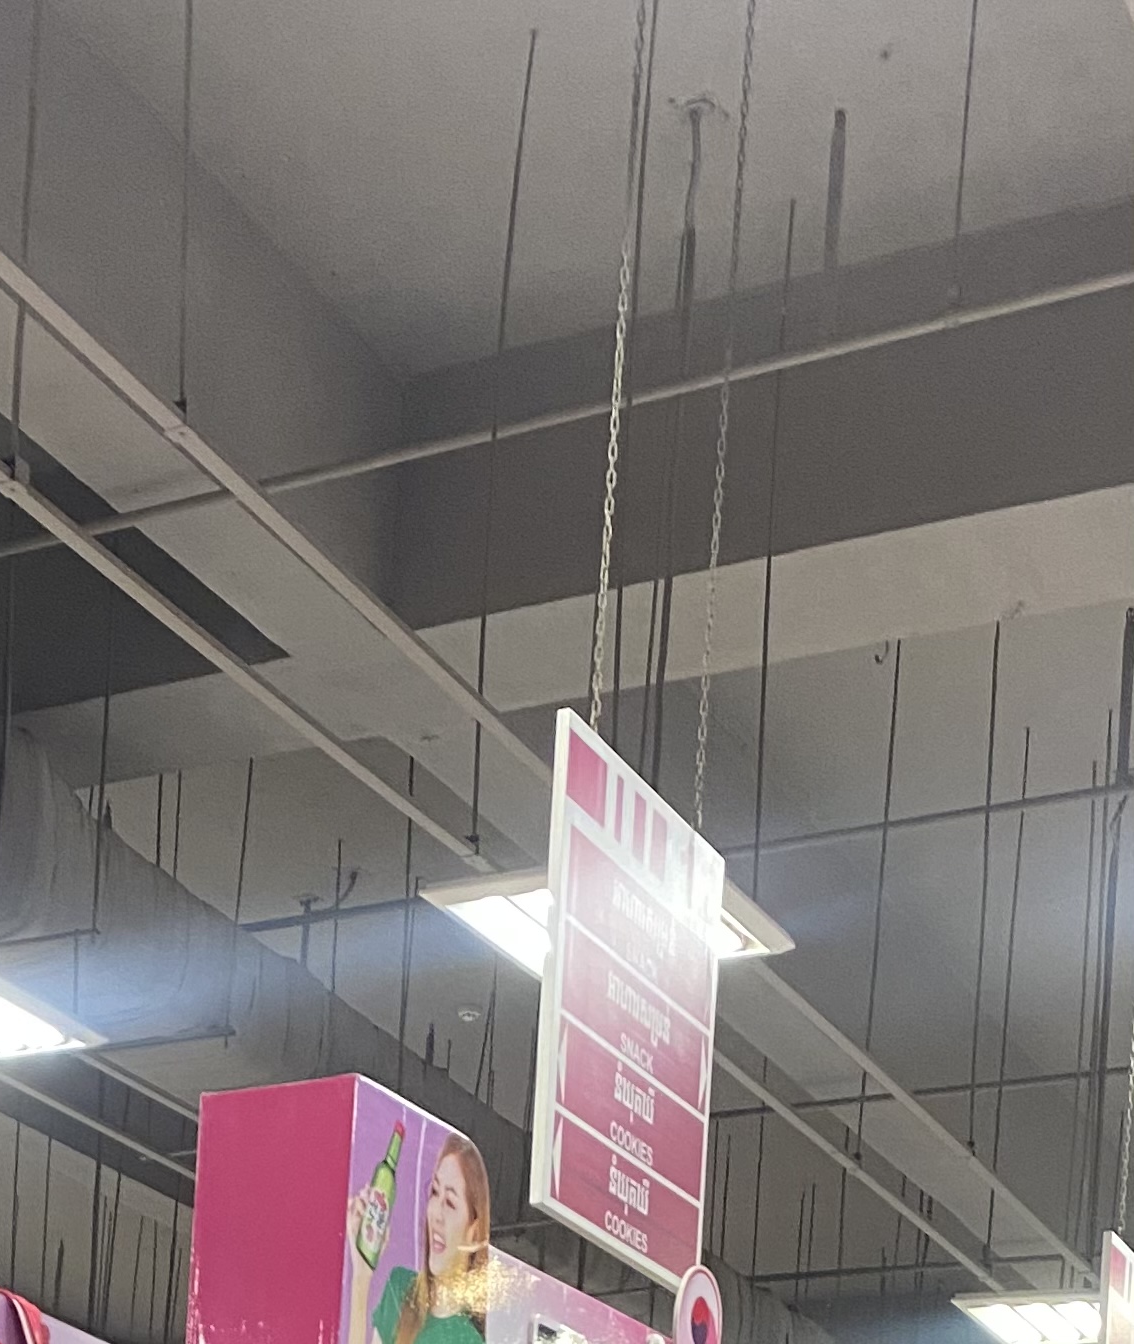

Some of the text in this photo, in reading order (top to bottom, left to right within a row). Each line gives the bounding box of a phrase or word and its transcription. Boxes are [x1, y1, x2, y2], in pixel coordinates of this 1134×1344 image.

[619, 1032, 654, 1075] SNACK
[609, 1119, 655, 1168] COOKIES
[603, 1209, 649, 1255] COOKIES
